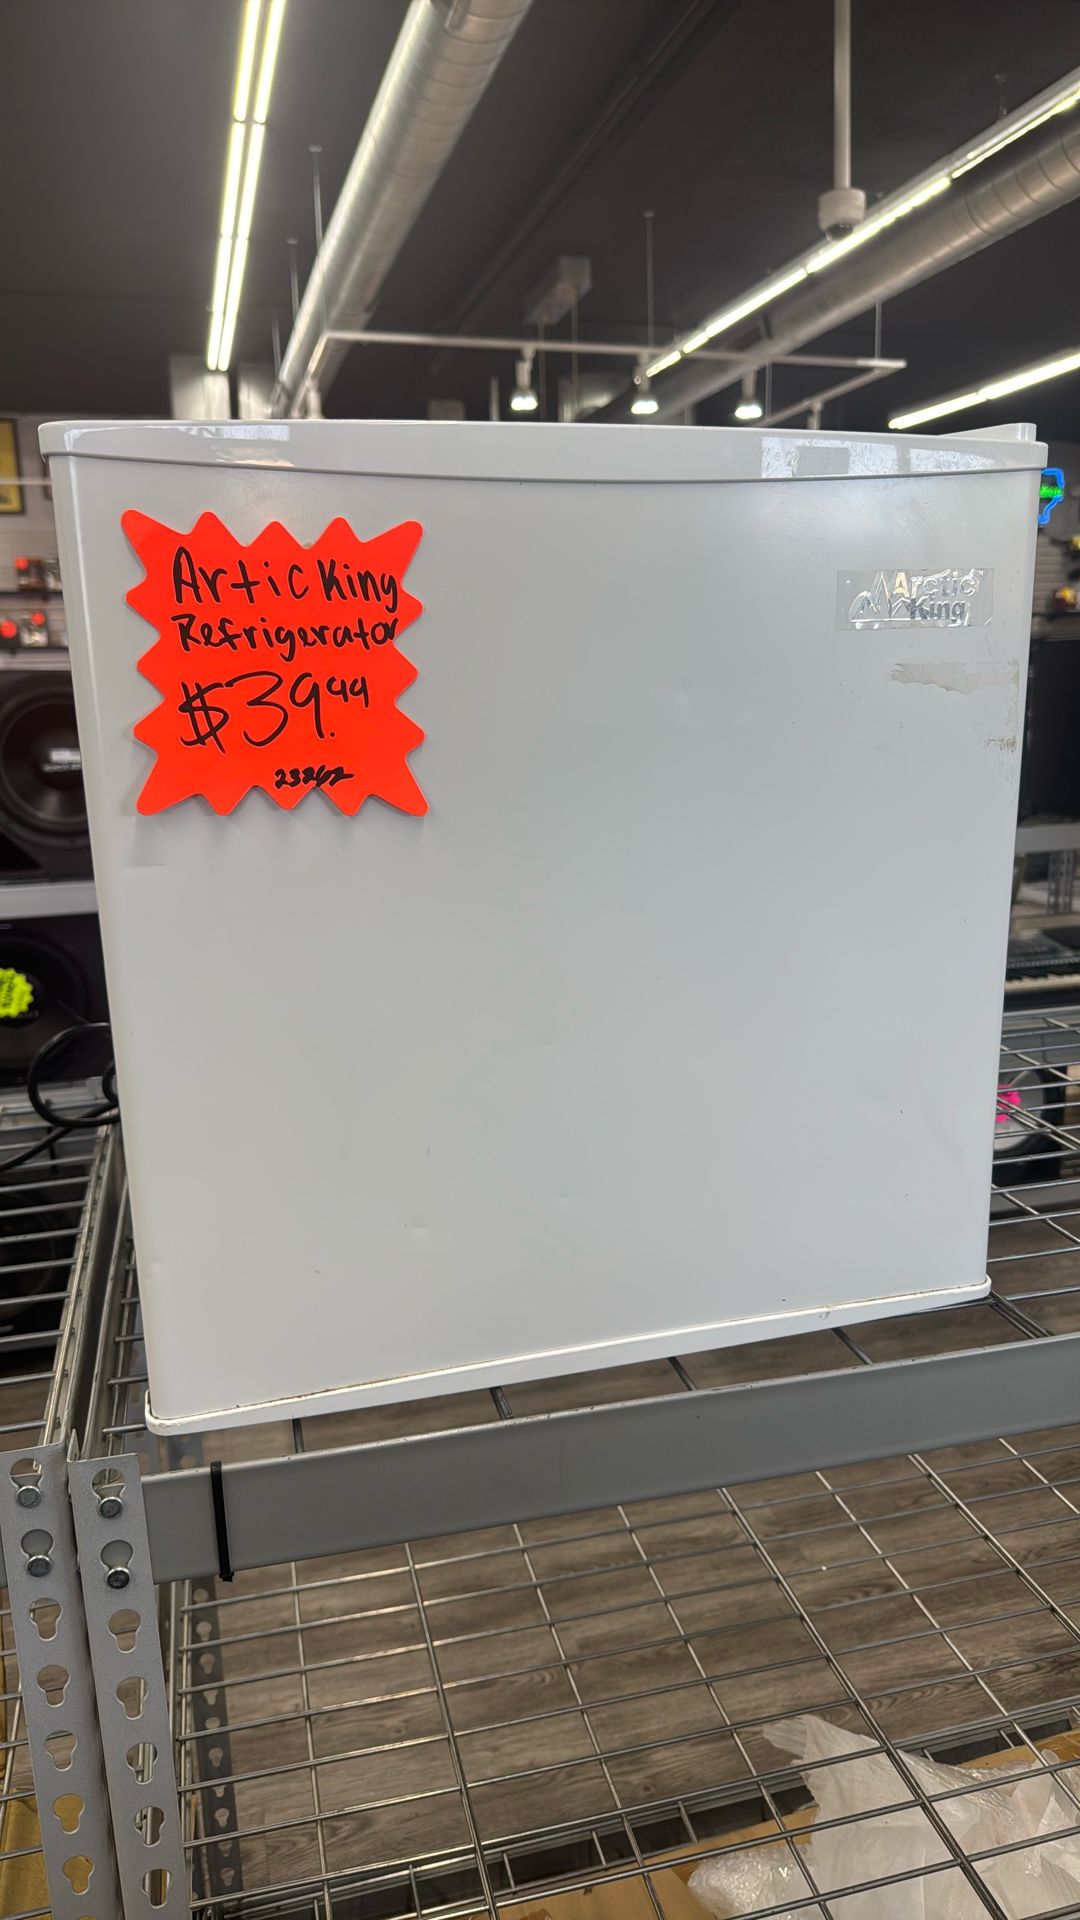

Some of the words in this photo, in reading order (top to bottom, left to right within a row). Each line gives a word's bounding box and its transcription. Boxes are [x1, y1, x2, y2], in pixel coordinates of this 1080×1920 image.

[172, 546, 309, 604] Artic
[316, 558, 398, 613] King
[892, 569, 979, 598] Arctic
[909, 596, 968, 626] King
[170, 613, 398, 662] Refrigerator
